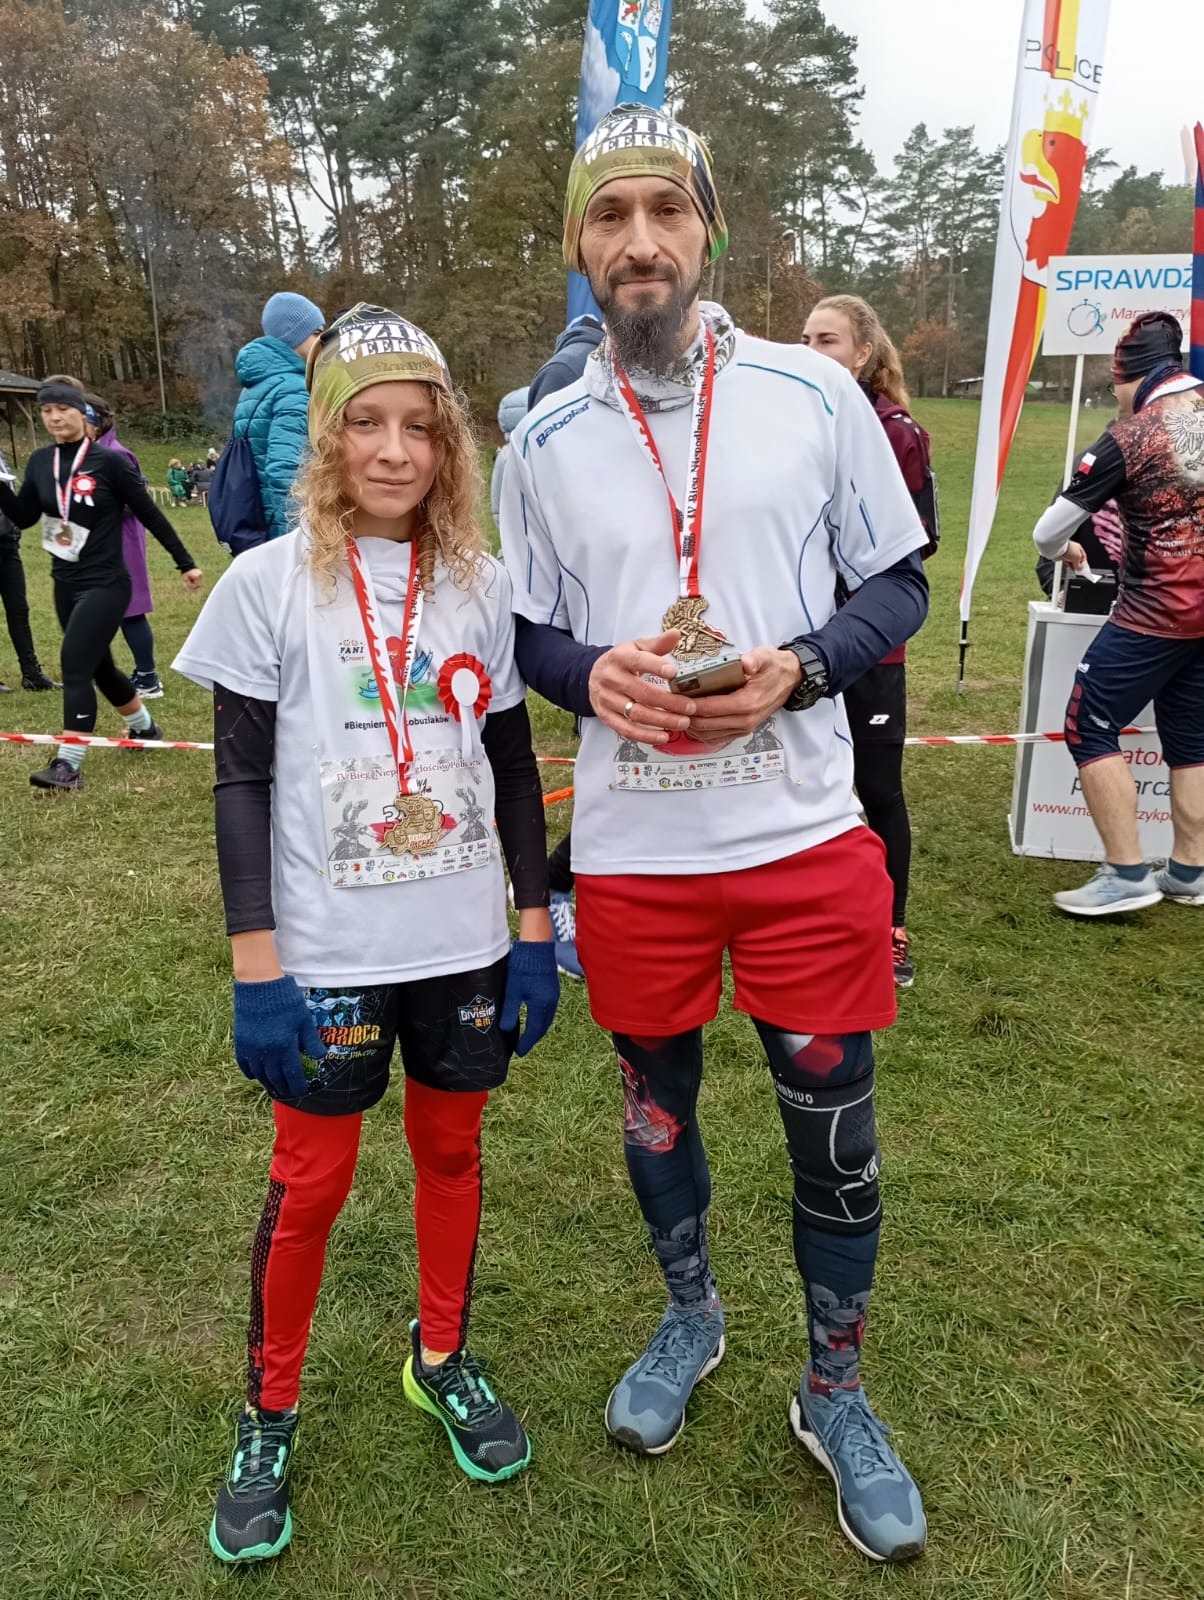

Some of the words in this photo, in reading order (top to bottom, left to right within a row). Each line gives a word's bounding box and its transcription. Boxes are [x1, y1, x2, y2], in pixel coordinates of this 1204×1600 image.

[688, 478, 699, 503] Bieg
[687, 506, 697, 518] IV
[345, 720, 388, 730] #Biegniem
